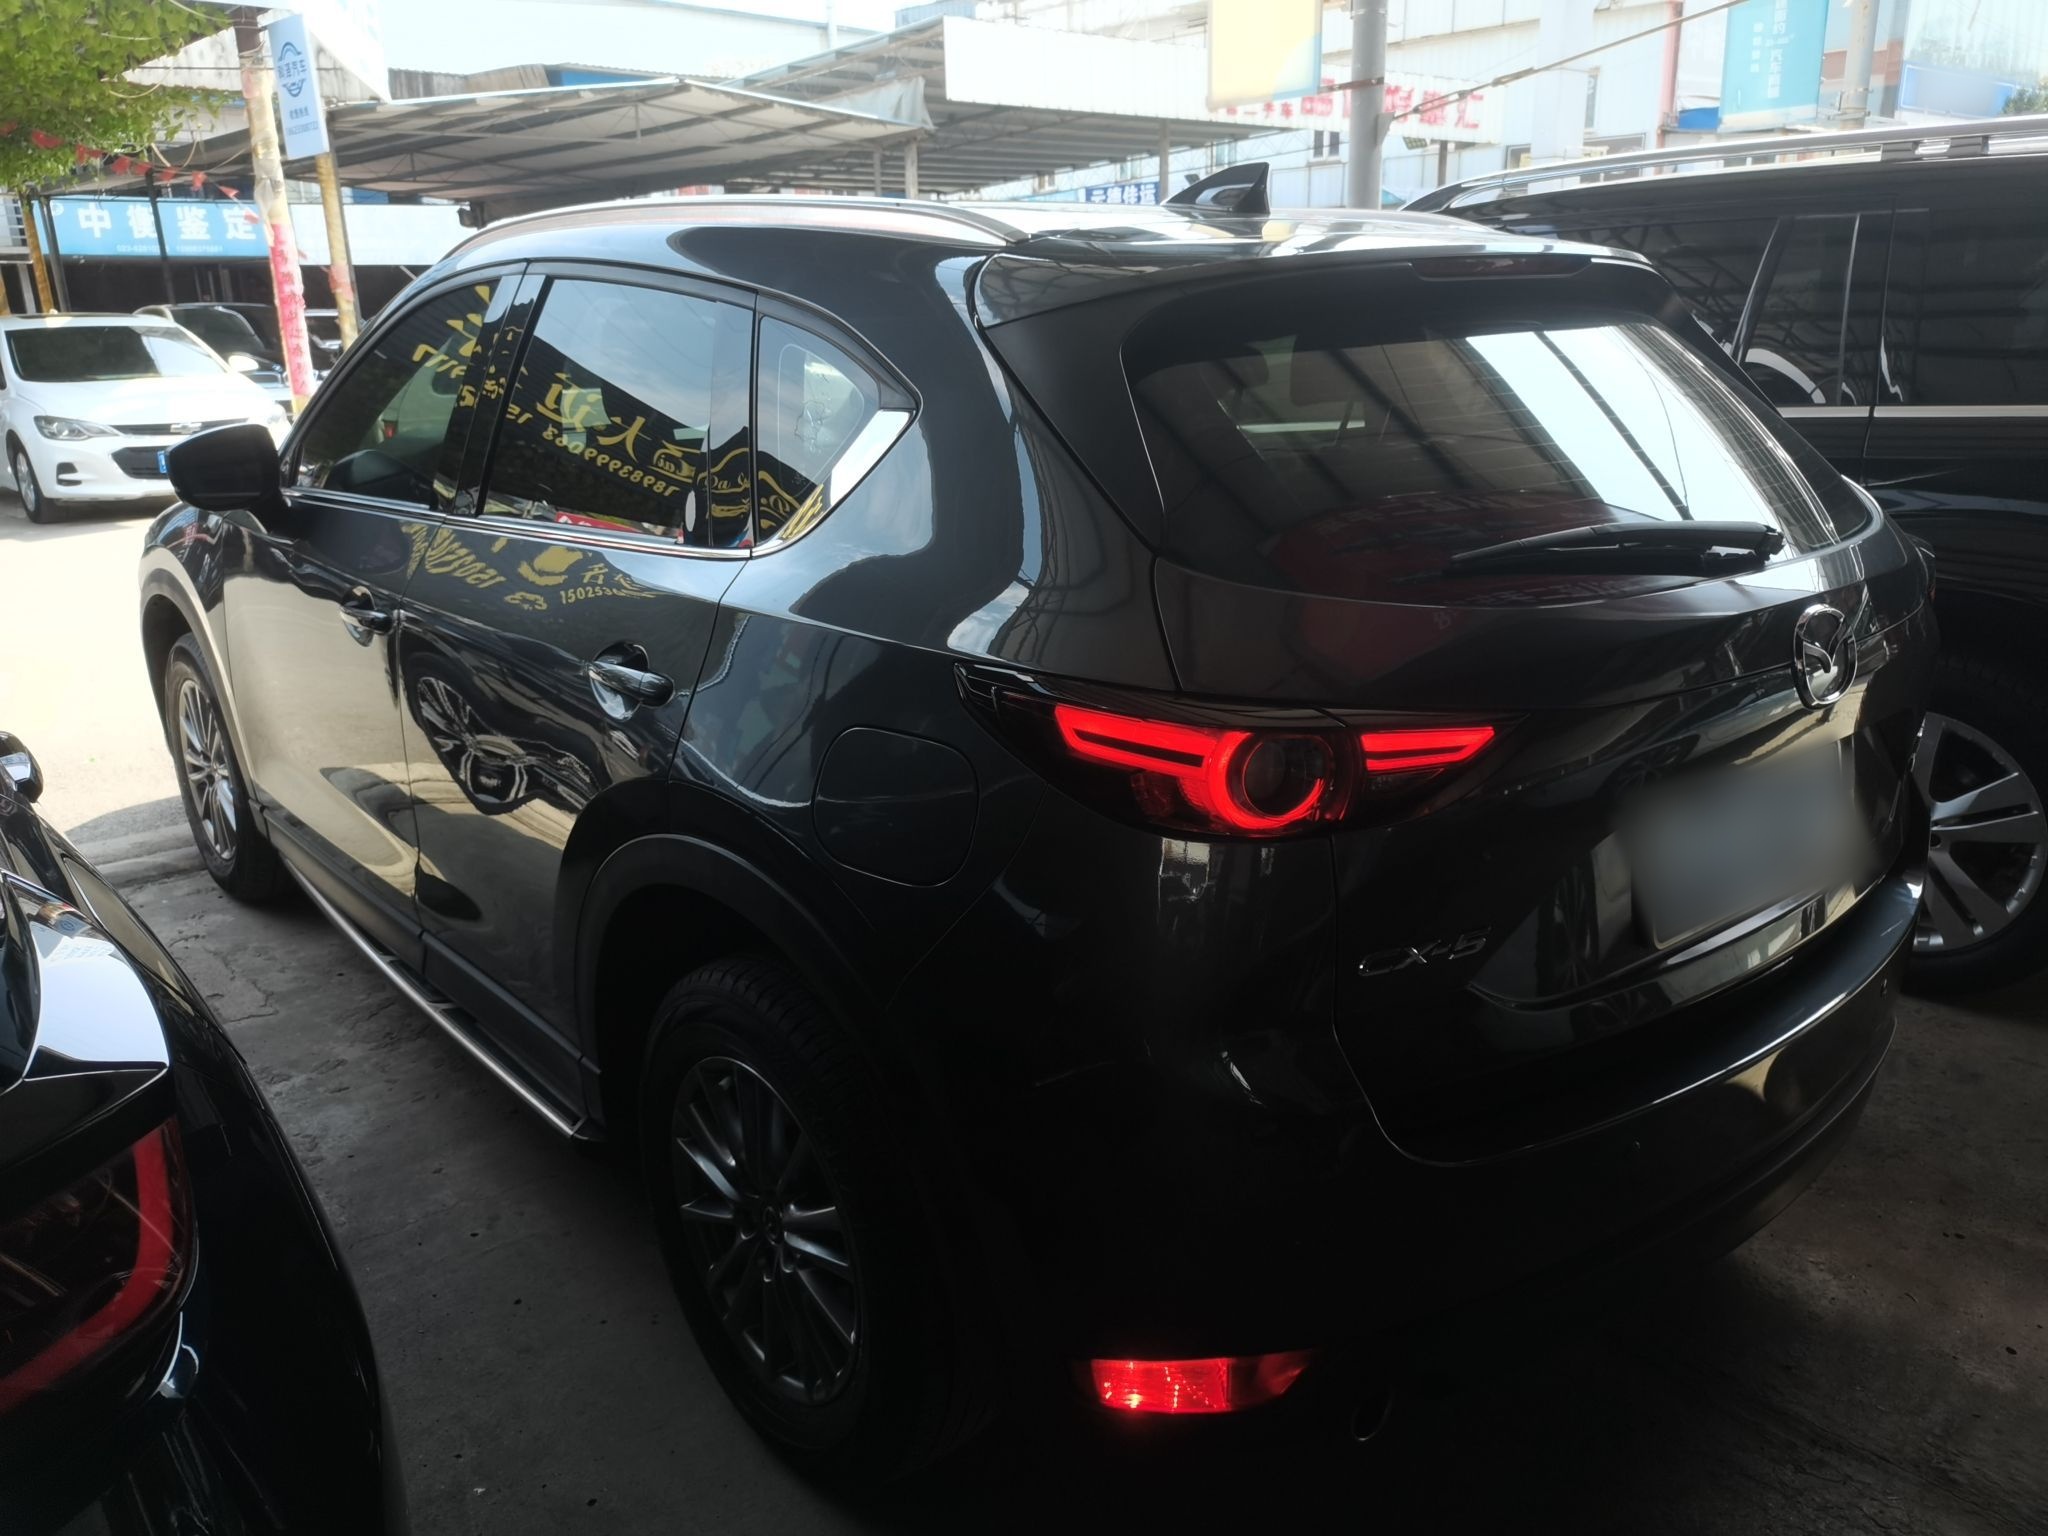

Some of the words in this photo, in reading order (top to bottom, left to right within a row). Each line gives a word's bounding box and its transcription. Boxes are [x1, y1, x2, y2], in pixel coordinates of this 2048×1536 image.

[77, 202, 256, 240] 中衡鉴定
[1358, 926, 1492, 977] CX-5
